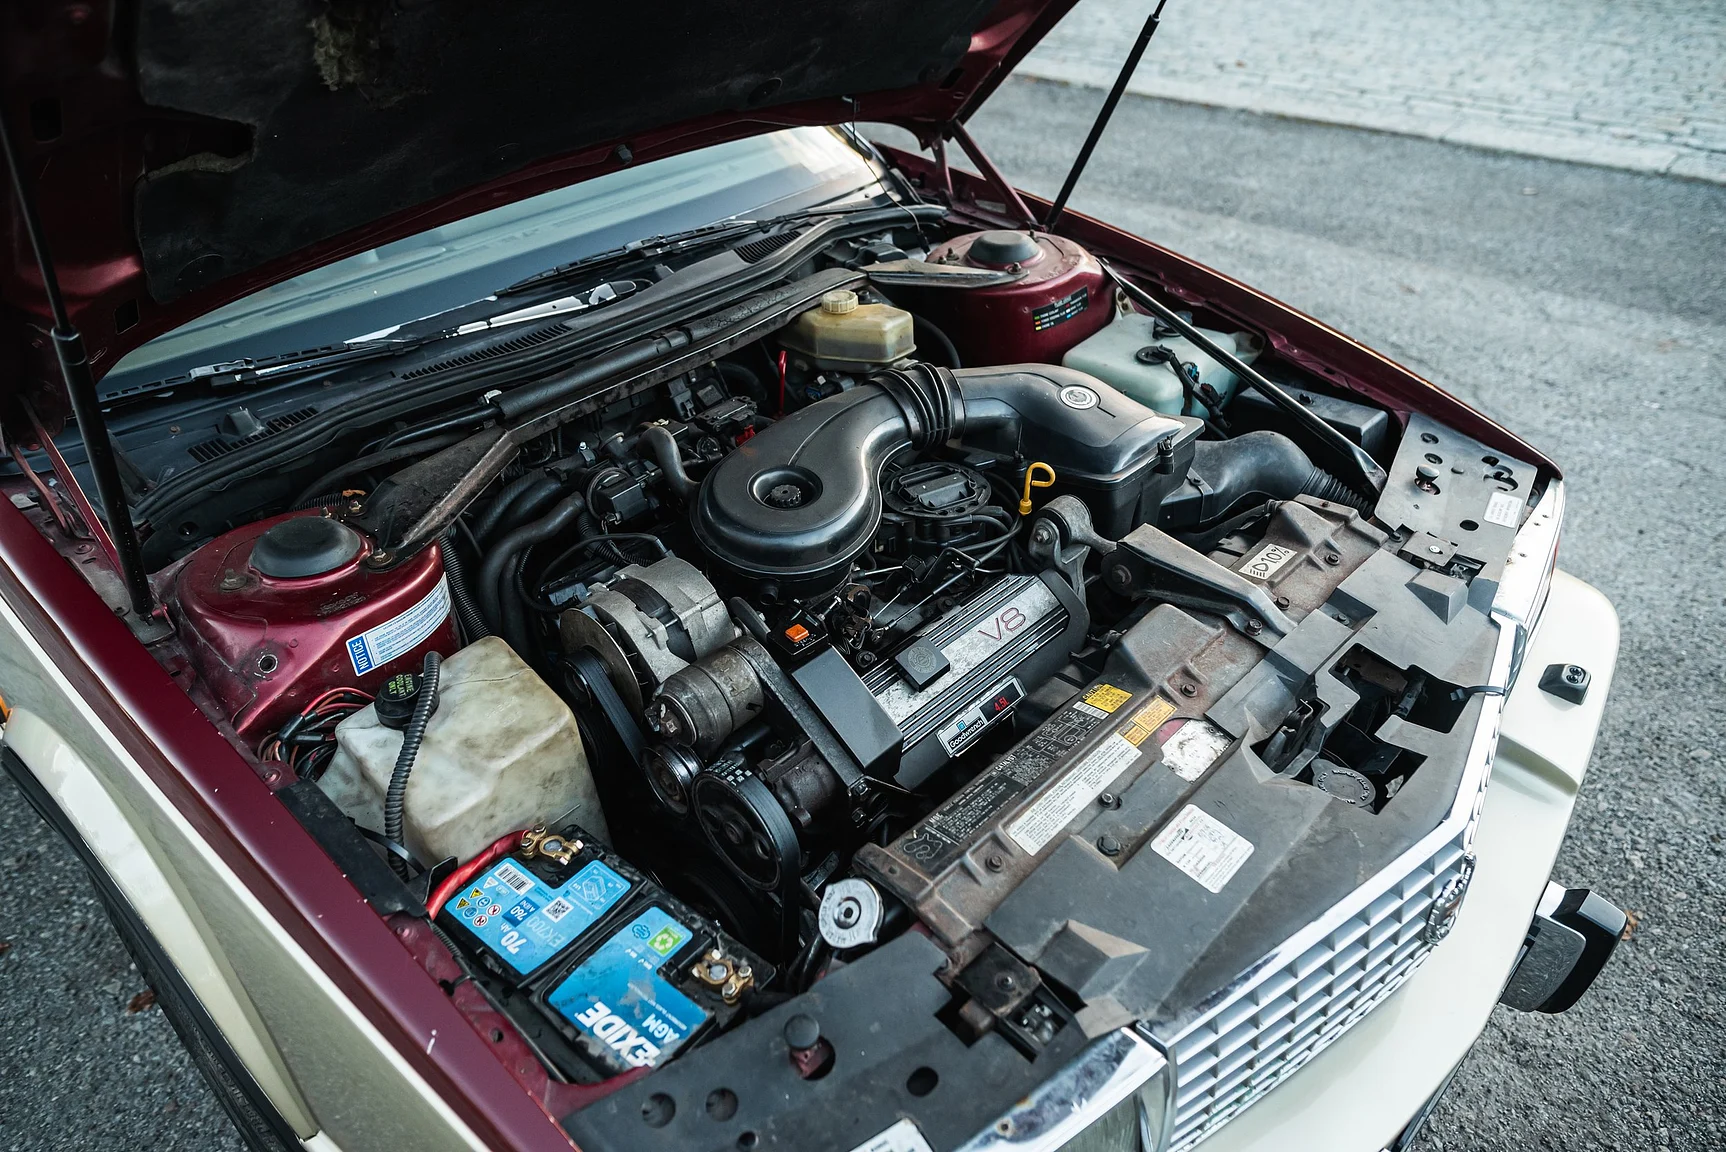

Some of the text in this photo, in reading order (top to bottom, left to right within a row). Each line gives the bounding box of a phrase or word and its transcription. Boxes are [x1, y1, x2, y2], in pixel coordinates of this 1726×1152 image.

[1261, 546, 1290, 563] 10%
[978, 607, 1027, 641] V8
[351, 640, 369, 670] NOTICE
[994, 696, 1009, 711] 4.5L
[949, 719, 984, 748] Goodwrench
[510, 906, 528, 921] 760
[500, 922, 527, 954] 70 Ah
[527, 916, 566, 947] EK700
[577, 1001, 660, 1067] EXIDE
[642, 1013, 680, 1043] AGM
